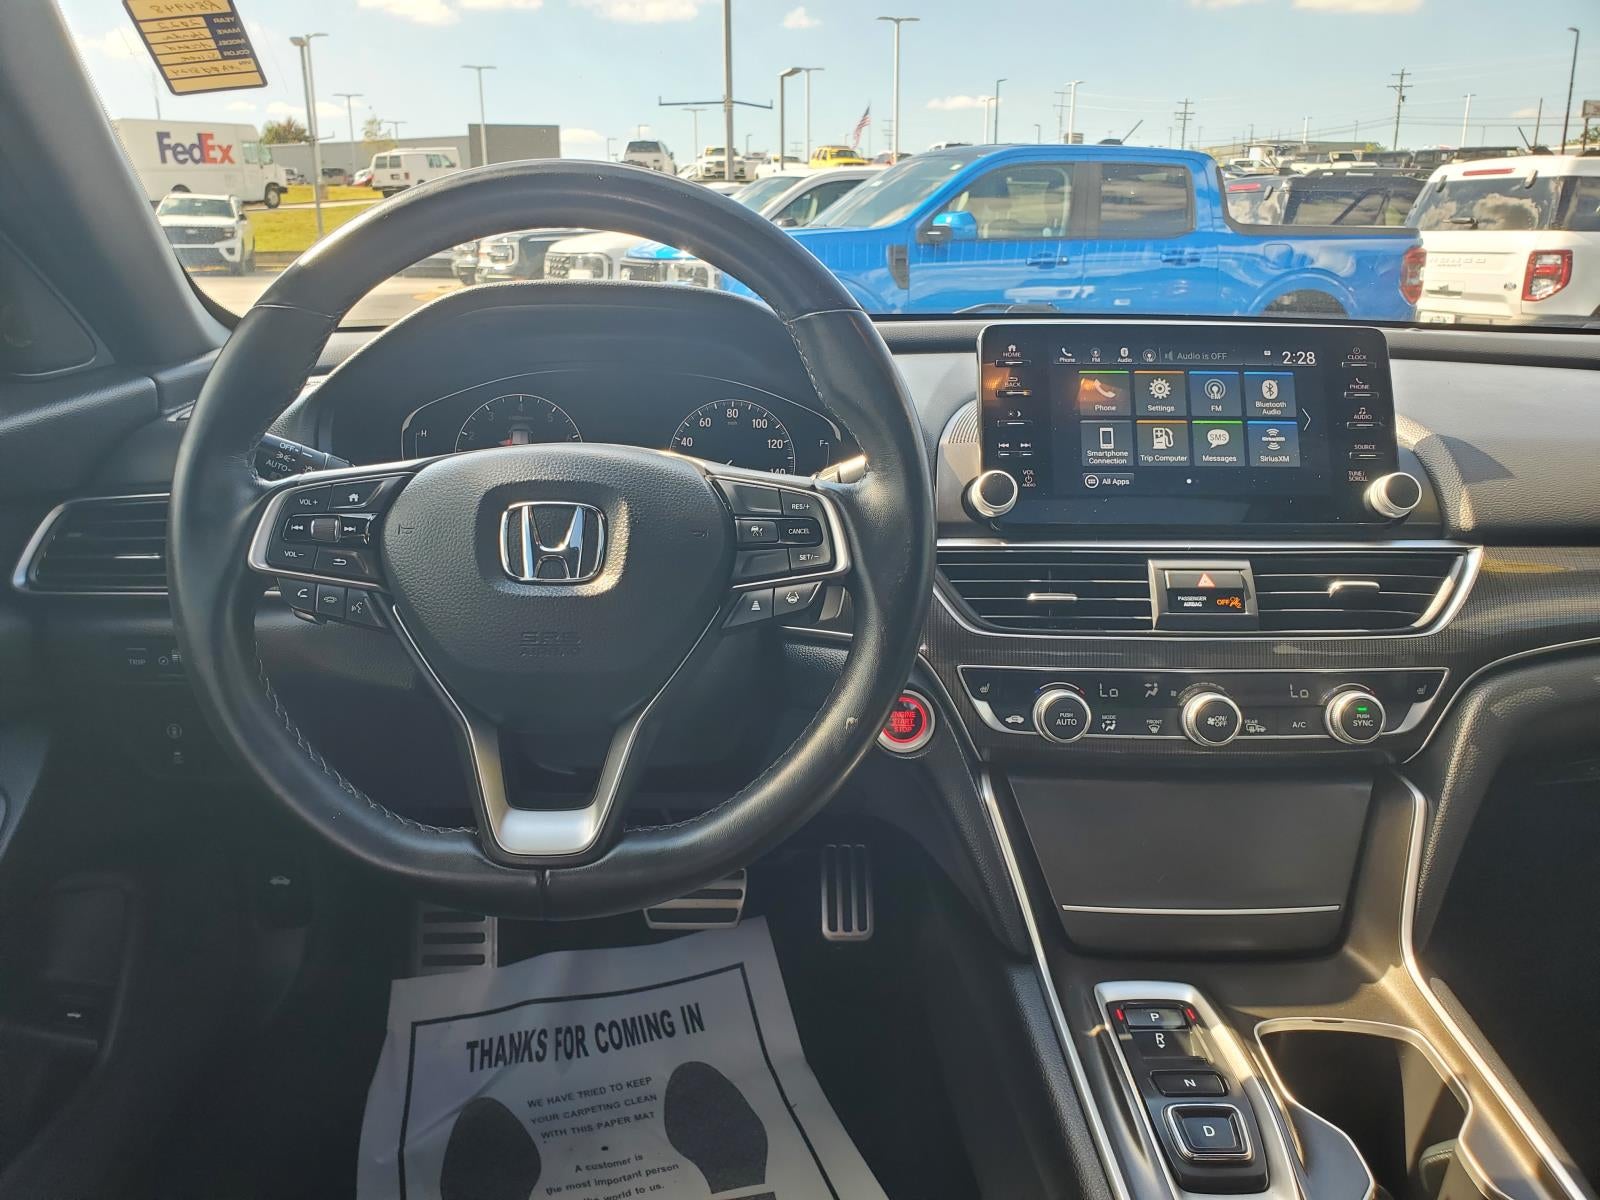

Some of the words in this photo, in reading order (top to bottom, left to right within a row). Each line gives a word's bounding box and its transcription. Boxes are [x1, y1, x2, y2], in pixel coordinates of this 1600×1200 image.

[156, 131, 235, 165] FedEx
[1176, 351, 1200, 361] Audio
[1202, 352, 1209, 361] is
[1210, 352, 1228, 361] OFF
[1282, 351, 1316, 365] 2:28
[1095, 404, 1117, 412] Phone
[1147, 404, 1175, 413] Settings
[1211, 404, 1222, 412] FM
[1255, 400, 1287, 409] Bluetooth
[726, 409, 739, 418] 80
[1262, 408, 1281, 416] Audio
[699, 418, 712, 427] 60
[752, 418, 768, 429] 100
[681, 437, 693, 447] 40
[1209, 433, 1227, 442] SMS
[767, 439, 783, 449] 120
[1087, 450, 1129, 460] Smartphone
[1140, 454, 1152, 463] Trip
[1153, 454, 1188, 463] Computer
[1202, 455, 1237, 463] Messages
[1260, 455, 1290, 463] SiriusXM
[1088, 457, 1127, 465] Connection
[1112, 478, 1130, 487] Apps
[1055, 718, 1078, 726] AUTO
[1352, 719, 1374, 727] SYNC
[1150, 1012, 1159, 1022] P
[466, 1029, 548, 1073] THANKS
[554, 1024, 590, 1062] FOR
[594, 1009, 676, 1054] COMING
[680, 1002, 705, 1035] IN
[1155, 1033, 1165, 1044] R
[1183, 1079, 1196, 1087] N
[527, 1098, 544, 1108] WE
[547, 1092, 573, 1105] HAVE
[577, 1086, 607, 1099] TRIED
[609, 1082, 624, 1092] TO
[626, 1076, 652, 1089] KEEP
[529, 1113, 560, 1125] YOUR
[563, 1101, 621, 1120] CARPETING
[624, 1094, 657, 1107] CLEAN
[540, 1129, 567, 1139] WITH
[570, 1124, 594, 1135] THIS
[597, 1116, 631, 1130] PAPER
[634, 1111, 655, 1121] MAT
[1203, 1126, 1215, 1137] D
[575, 1165, 583, 1173] A
[585, 1158, 631, 1171] customer
[634, 1153, 643, 1161] is
[546, 1185, 562, 1195] the
[565, 1180, 591, 1191] most
[594, 1170, 642, 1187] important
[645, 1163, 680, 1177] person
[604, 1190, 632, 1200] world
[635, 1186, 646, 1194] to
[649, 1183, 665, 1192] us.
